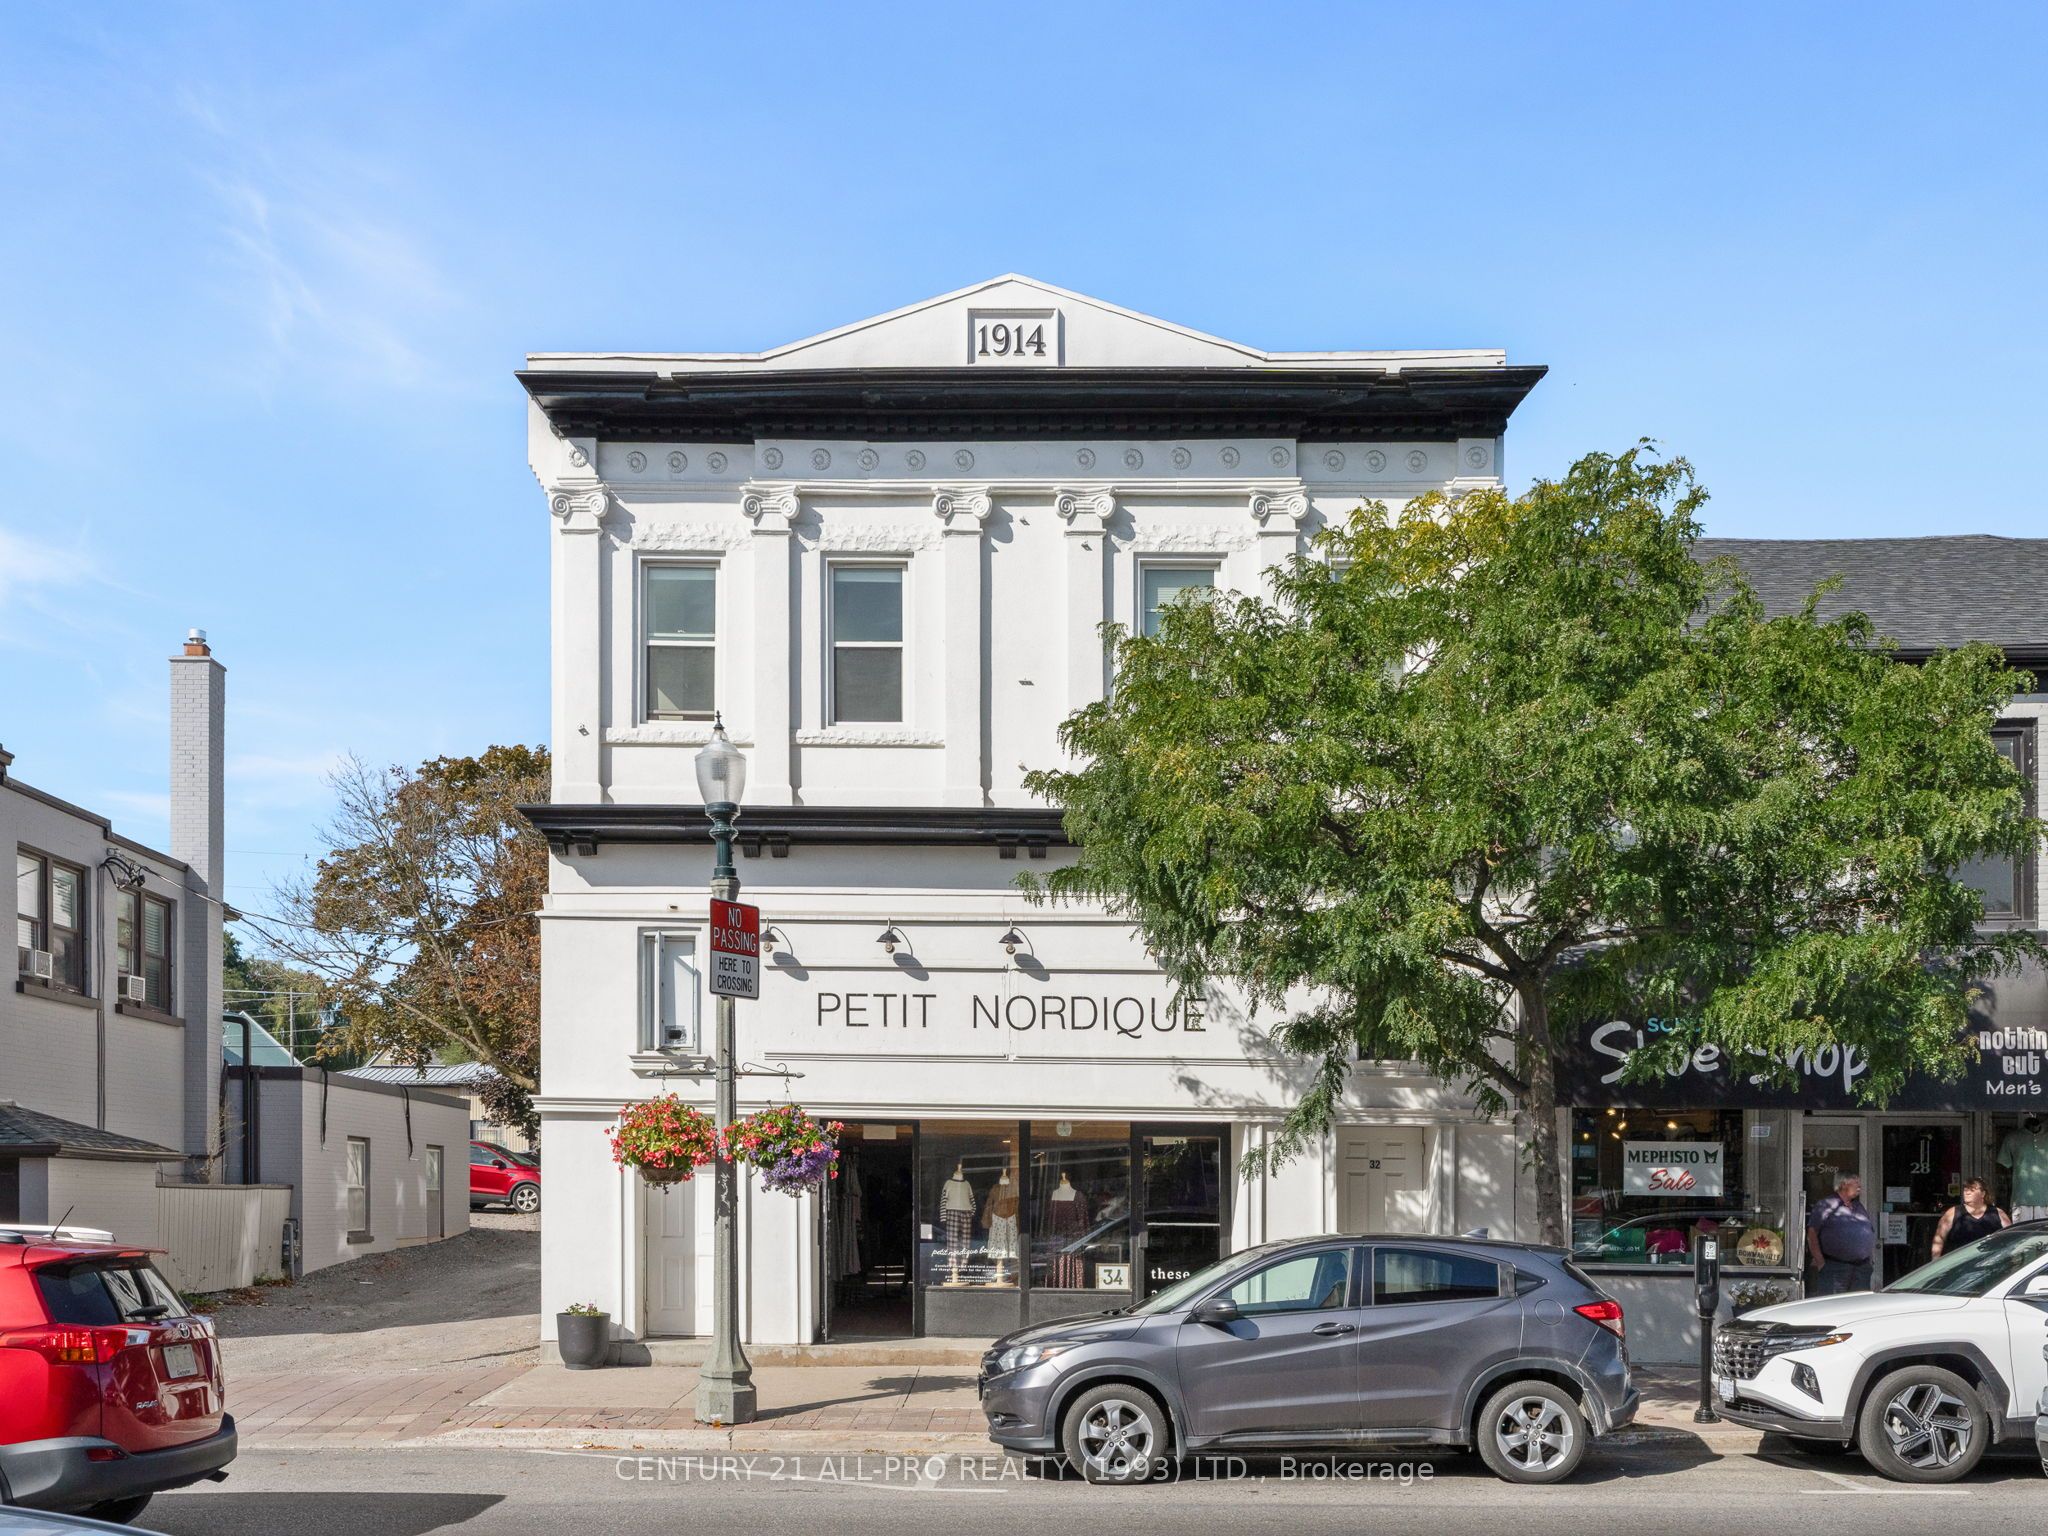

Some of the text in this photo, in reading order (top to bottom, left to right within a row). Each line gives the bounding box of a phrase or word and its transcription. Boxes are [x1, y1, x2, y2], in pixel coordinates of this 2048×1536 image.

[977, 323, 1047, 356] 1914
[728, 907, 742, 928] NO
[713, 926, 757, 952] PASSING
[718, 956, 752, 974] HERE TO
[716, 974, 753, 993] CROSSING
[817, 992, 1207, 1039] PETIT NORDIQUE
[1986, 1080, 2042, 1095] Men's
[1369, 1160, 1381, 1169] 32
[1628, 1150, 1700, 1164] MEPHISTO
[1910, 1162, 1931, 1174] 28
[1648, 1169, 1698, 1191] Sale
[1103, 1269, 1124, 1285] 34
[1151, 1267, 1191, 1280] these
